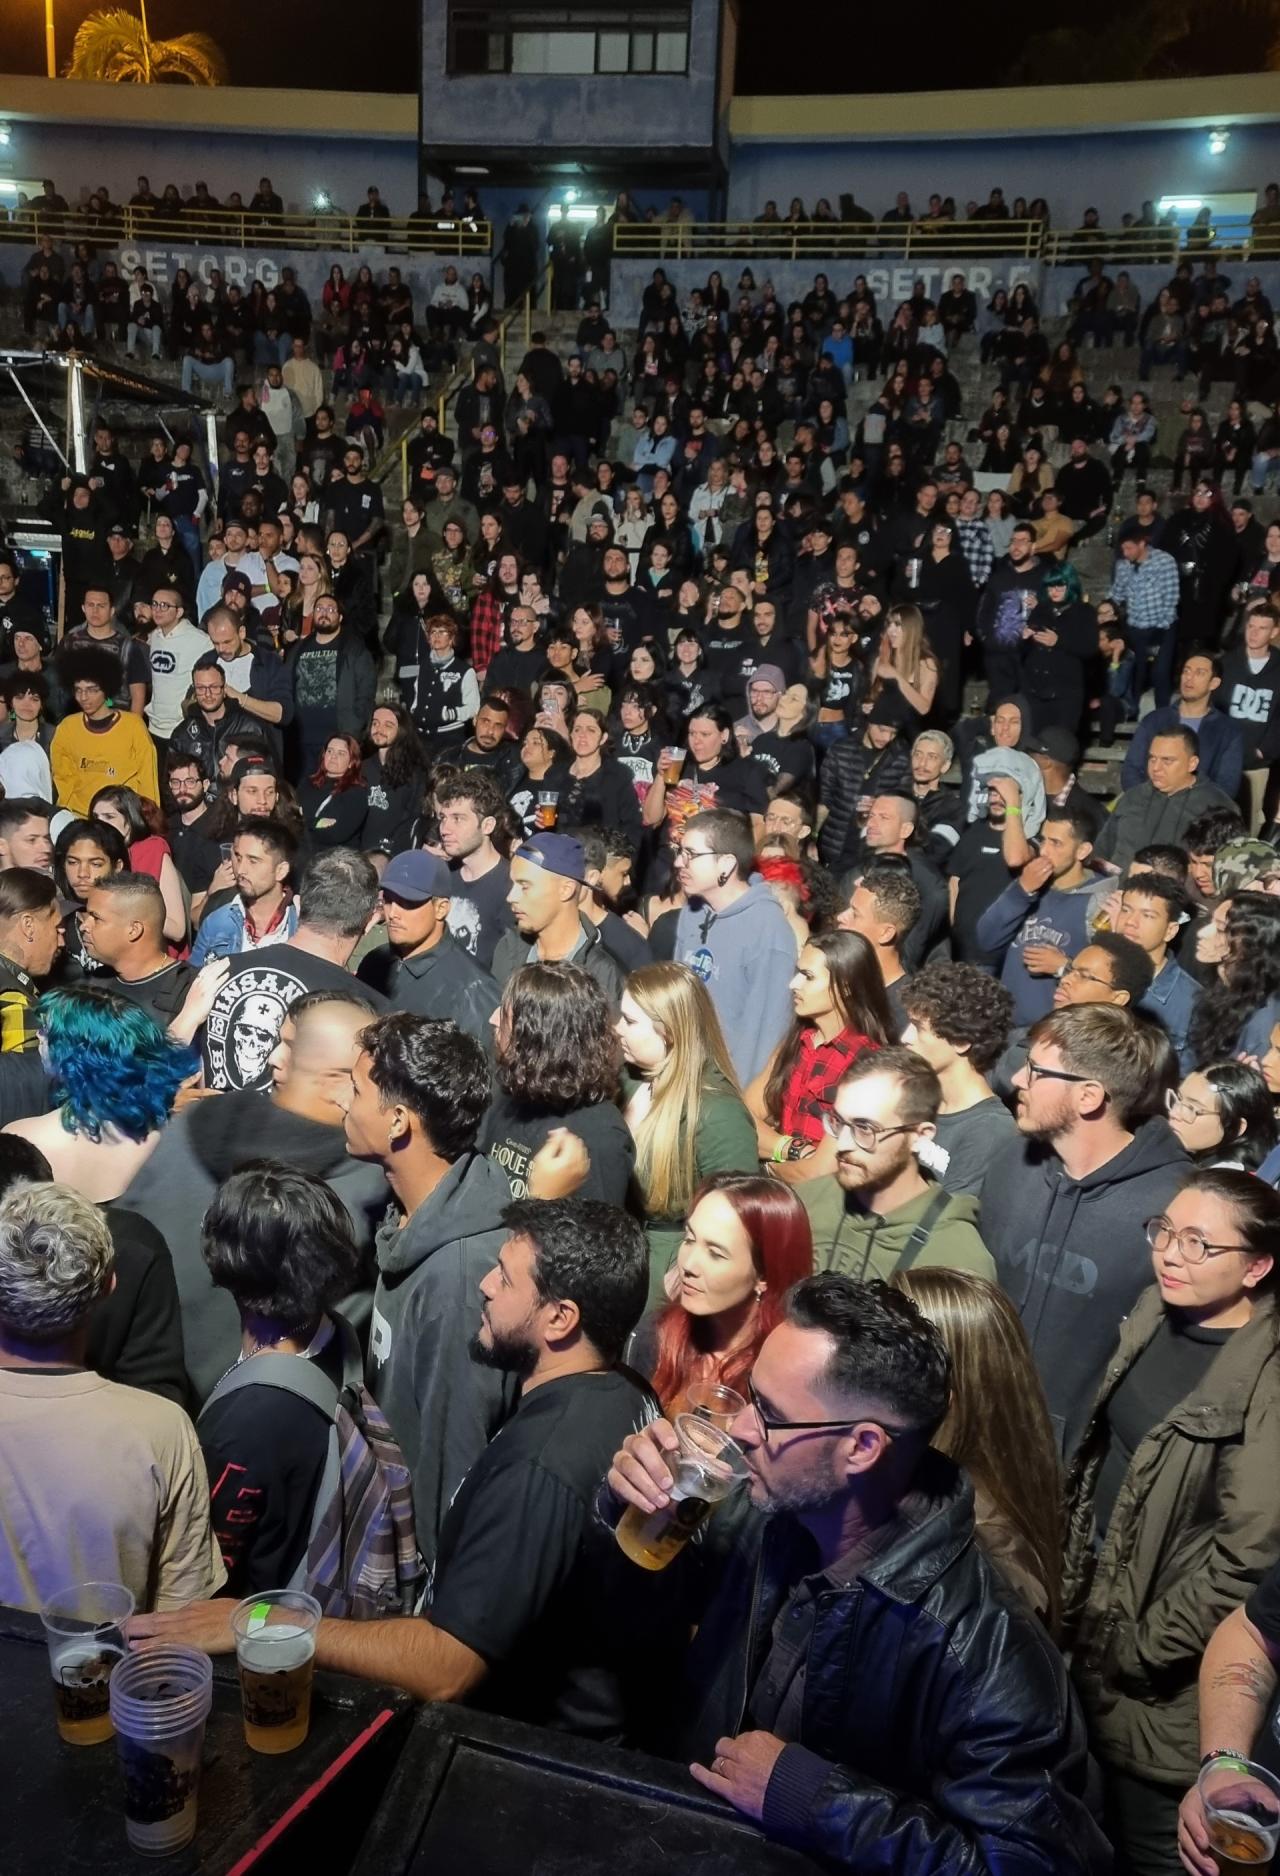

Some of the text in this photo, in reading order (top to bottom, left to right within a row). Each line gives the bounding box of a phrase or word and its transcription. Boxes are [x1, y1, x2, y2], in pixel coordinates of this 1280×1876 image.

[1229, 683, 1274, 723] DC
[215, 972, 305, 1014] INSAN
[211, 1016, 225, 1036] 18
